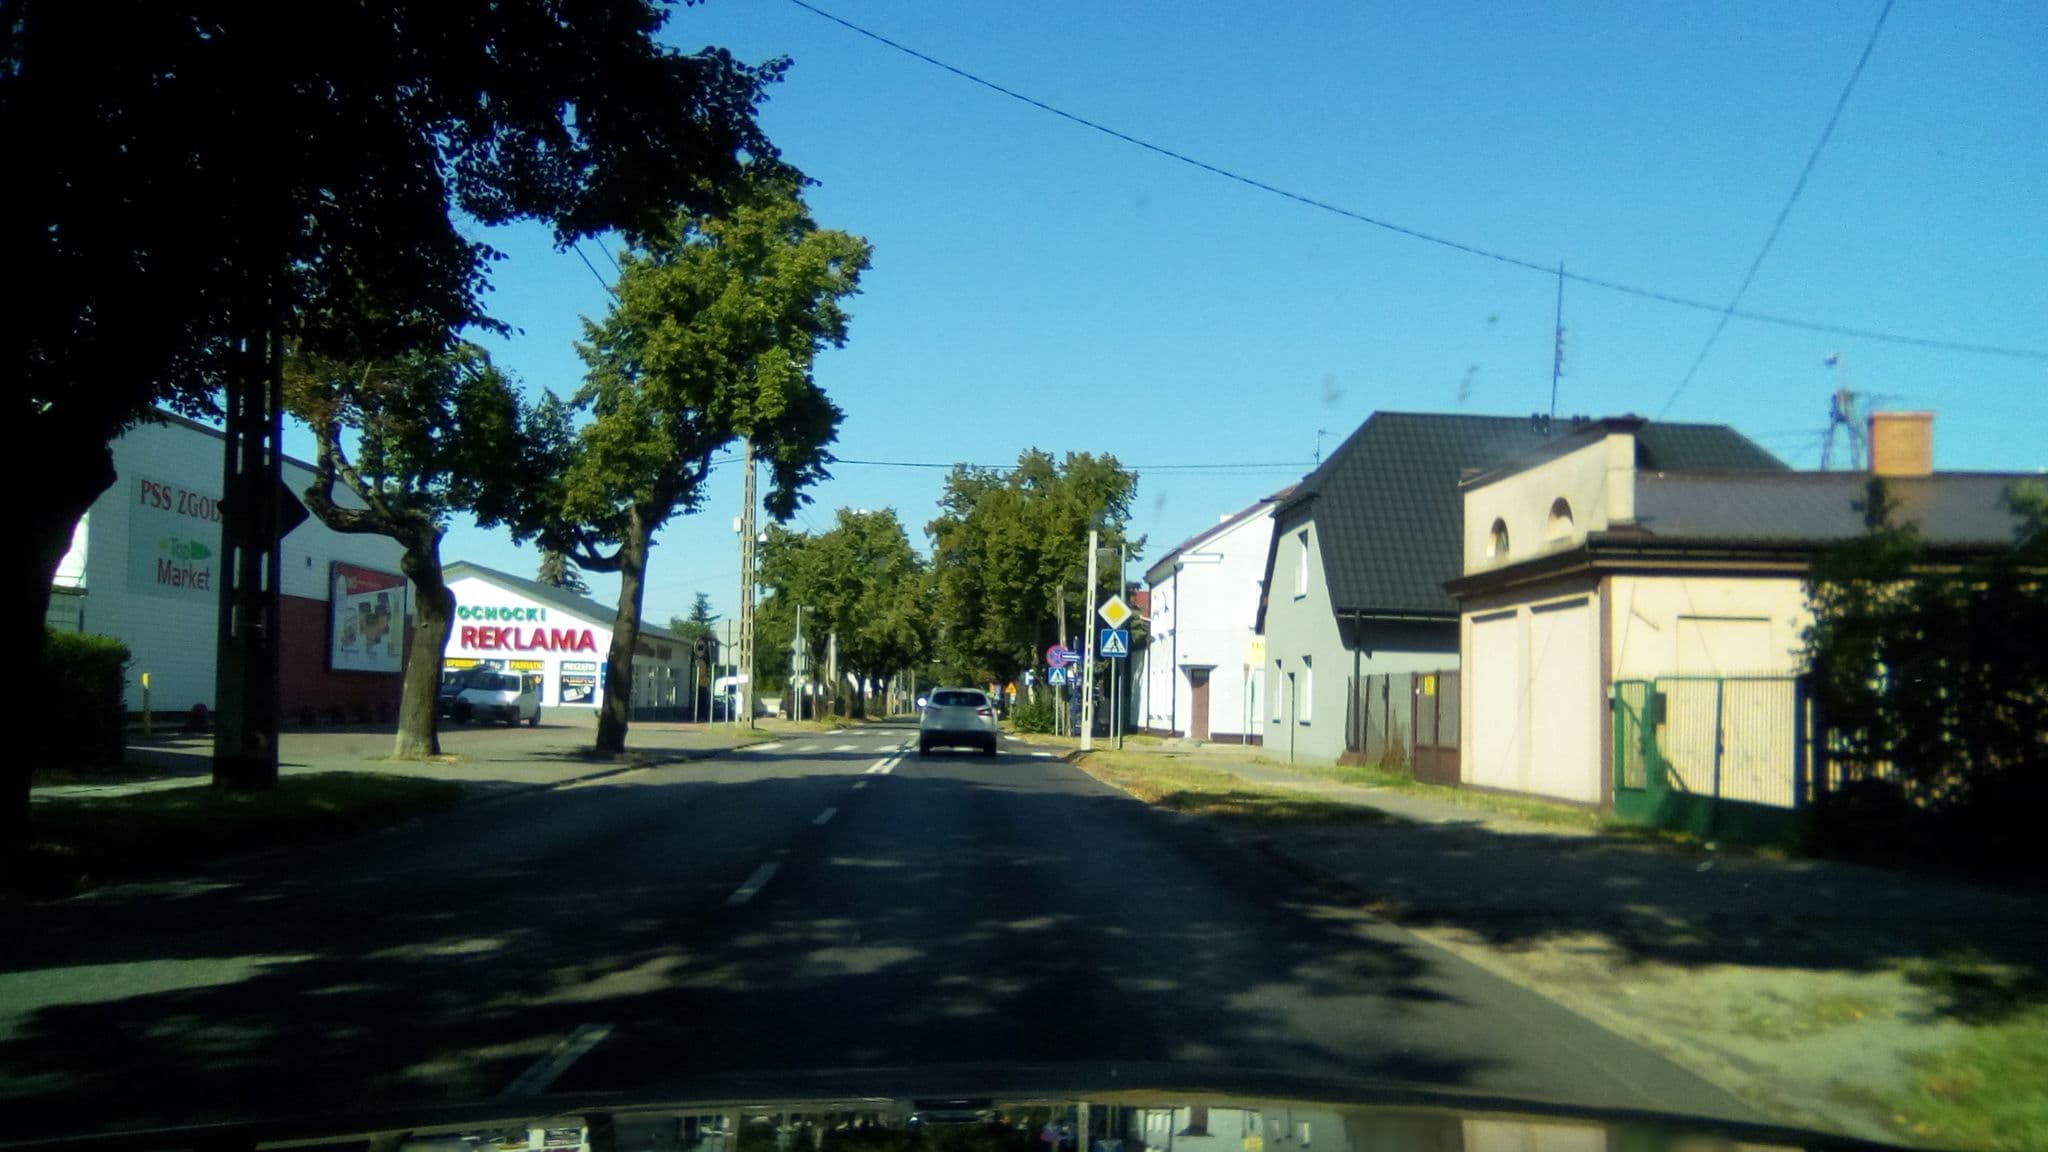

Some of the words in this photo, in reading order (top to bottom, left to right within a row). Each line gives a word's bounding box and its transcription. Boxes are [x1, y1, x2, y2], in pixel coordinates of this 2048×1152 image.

[141, 480, 172, 510] PSS
[157, 558, 210, 591] Market
[461, 626, 598, 653] REKLAMA
